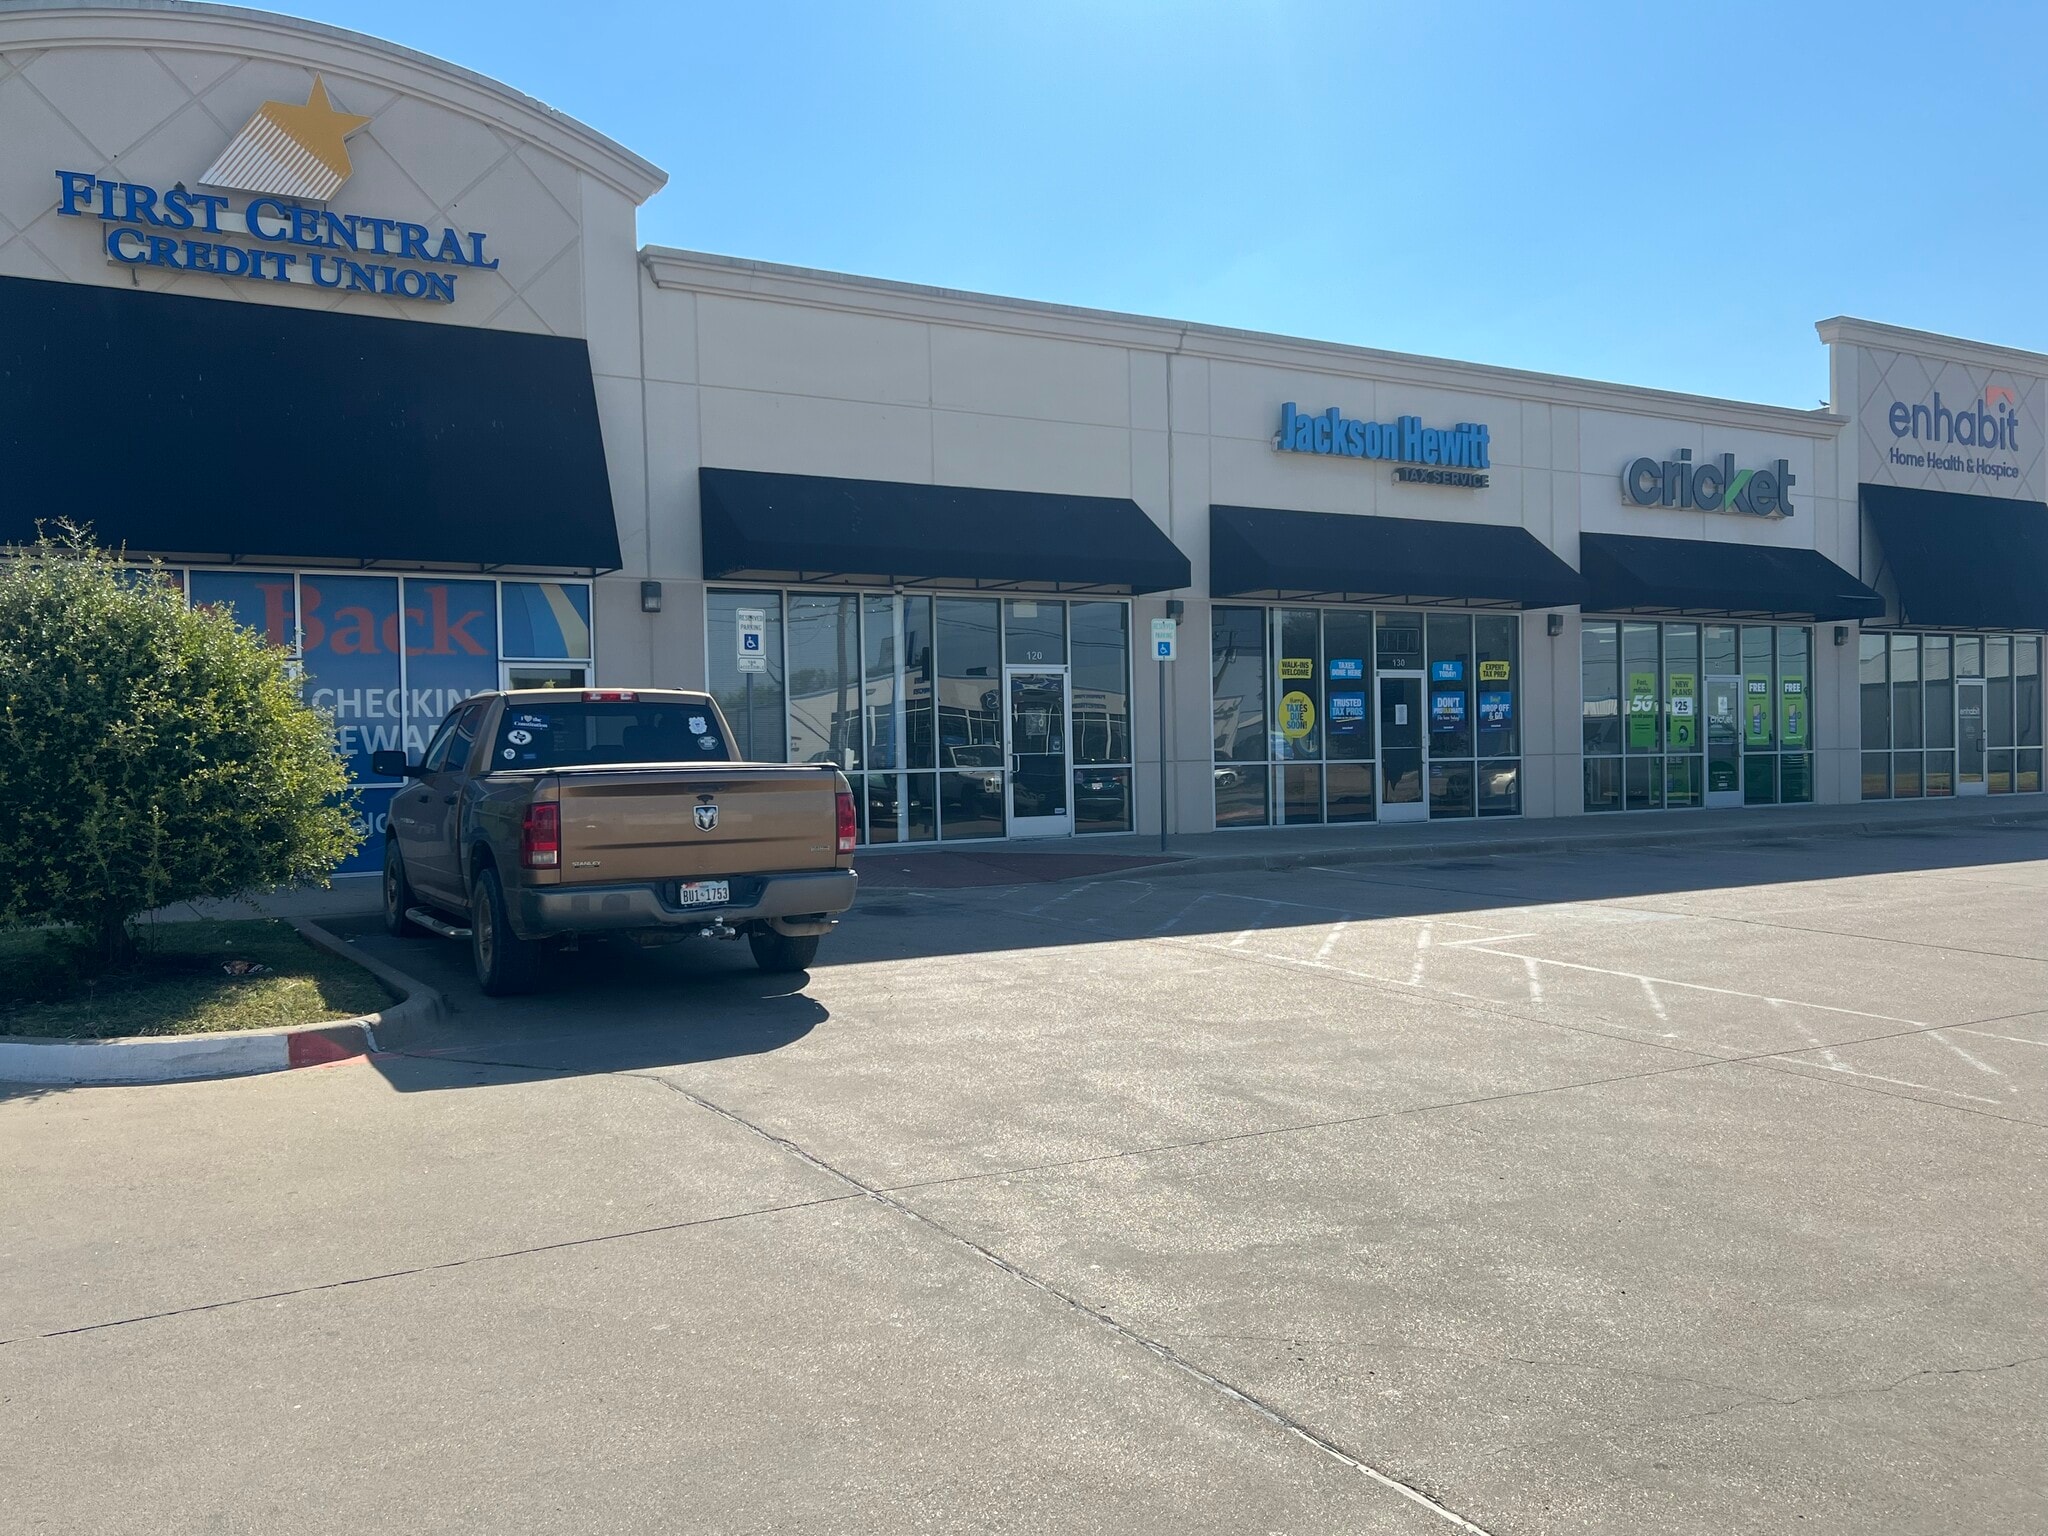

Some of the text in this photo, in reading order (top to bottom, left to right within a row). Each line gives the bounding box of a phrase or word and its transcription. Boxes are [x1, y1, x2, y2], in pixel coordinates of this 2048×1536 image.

[55, 170, 499, 270] FIRST CENTRAL
[107, 228, 458, 304] CREDIT UNION
[1889, 391, 2019, 452] enhabit
[1281, 401, 1490, 469] Jackson Hewitt
[1889, 447, 2019, 480] Home Health & Hospice
[1402, 467, 1490, 489] TAX SERVICE
[1624, 448, 1796, 517] cricket
[256, 582, 489, 657] Back
[1026, 651, 1043, 661] 120
[1393, 659, 1406, 667] 130
[1281, 668, 1310, 676] WELCOME
[1331, 669, 1362, 677] DONE HERE
[1483, 670, 1493, 678] TAX
[1748, 682, 1766, 692] FREE
[1784, 683, 1801, 692] FREE
[1333, 698, 1362, 707] TRUSTED
[1437, 697, 1460, 708] DON'T
[1631, 694, 1654, 712] 5G
[1675, 701, 1688, 711] $25
[1286, 704, 1308, 712] TAXES
[1332, 707, 1363, 716] TAX PROS
[1481, 704, 1510, 713] DROP OFF
[1290, 712, 1304, 720] DUE
